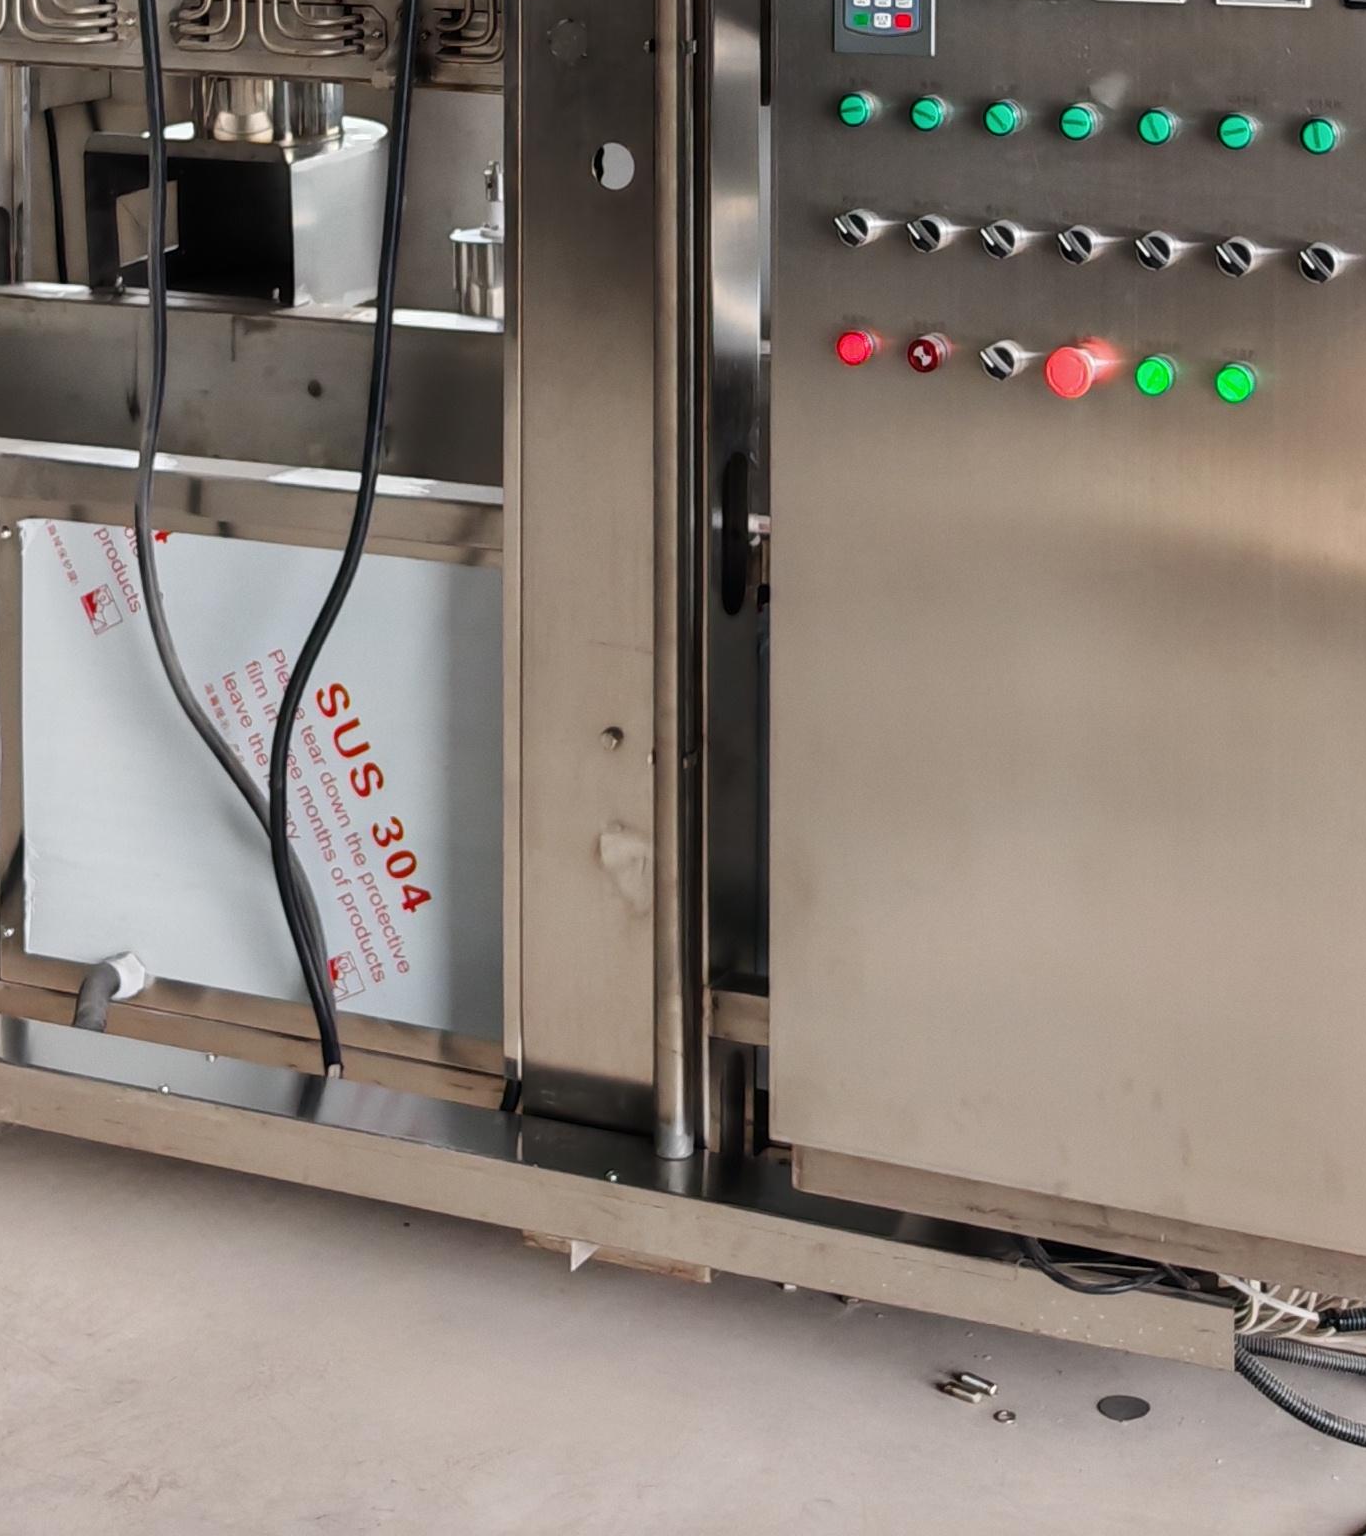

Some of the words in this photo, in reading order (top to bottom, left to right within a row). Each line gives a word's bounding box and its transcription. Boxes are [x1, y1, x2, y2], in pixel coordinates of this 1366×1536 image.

[93, 527, 141, 614] products
[222, 671, 253, 729] leave
[248, 731, 269, 767] the
[245, 659, 268, 699] film
[268, 649, 306, 721] Plee
[300, 725, 326, 766] tear
[319, 770, 351, 829] down
[344, 831, 367, 867] the
[357, 872, 410, 974] protective
[297, 784, 336, 862] months
[315, 682, 385, 798] SUS
[372, 816, 432, 913] 304
[331, 866, 352, 888] of
[337, 892, 385, 984] products
